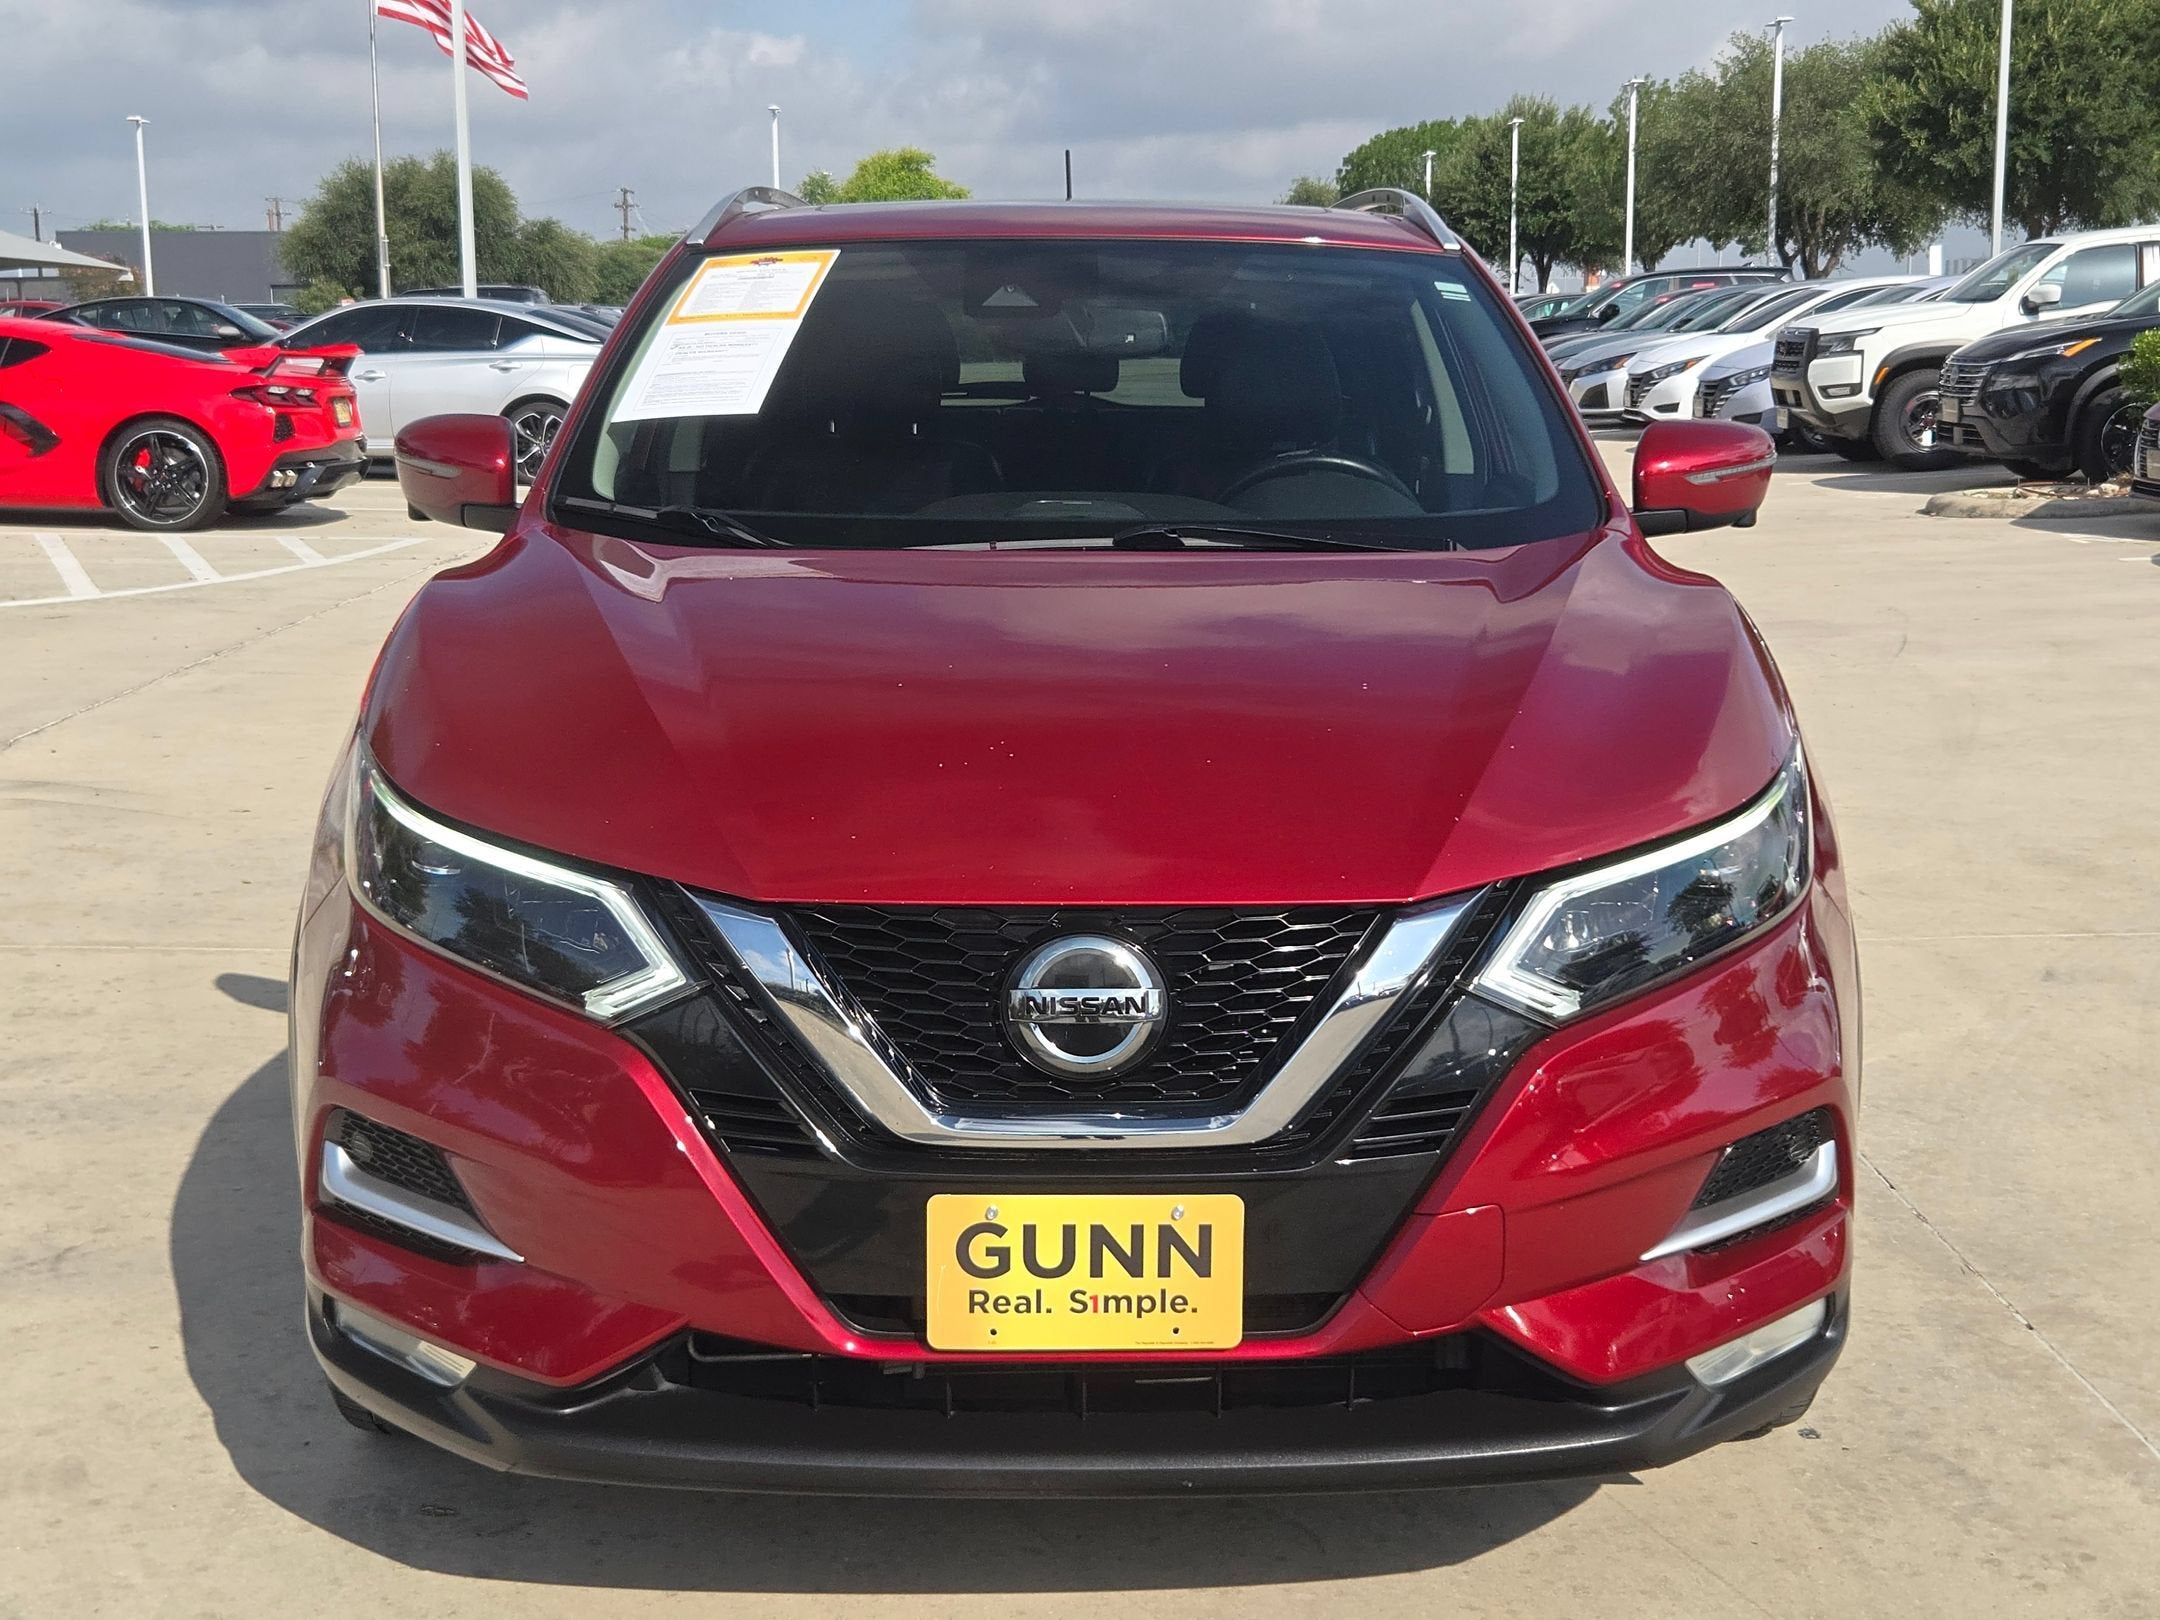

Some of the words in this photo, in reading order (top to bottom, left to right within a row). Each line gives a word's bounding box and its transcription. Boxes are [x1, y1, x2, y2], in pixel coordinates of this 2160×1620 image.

[1025, 996, 1146, 1015] NISSAN
[955, 1222, 1212, 1279] GUNN
[968, 1289, 1052, 1314] Real.
